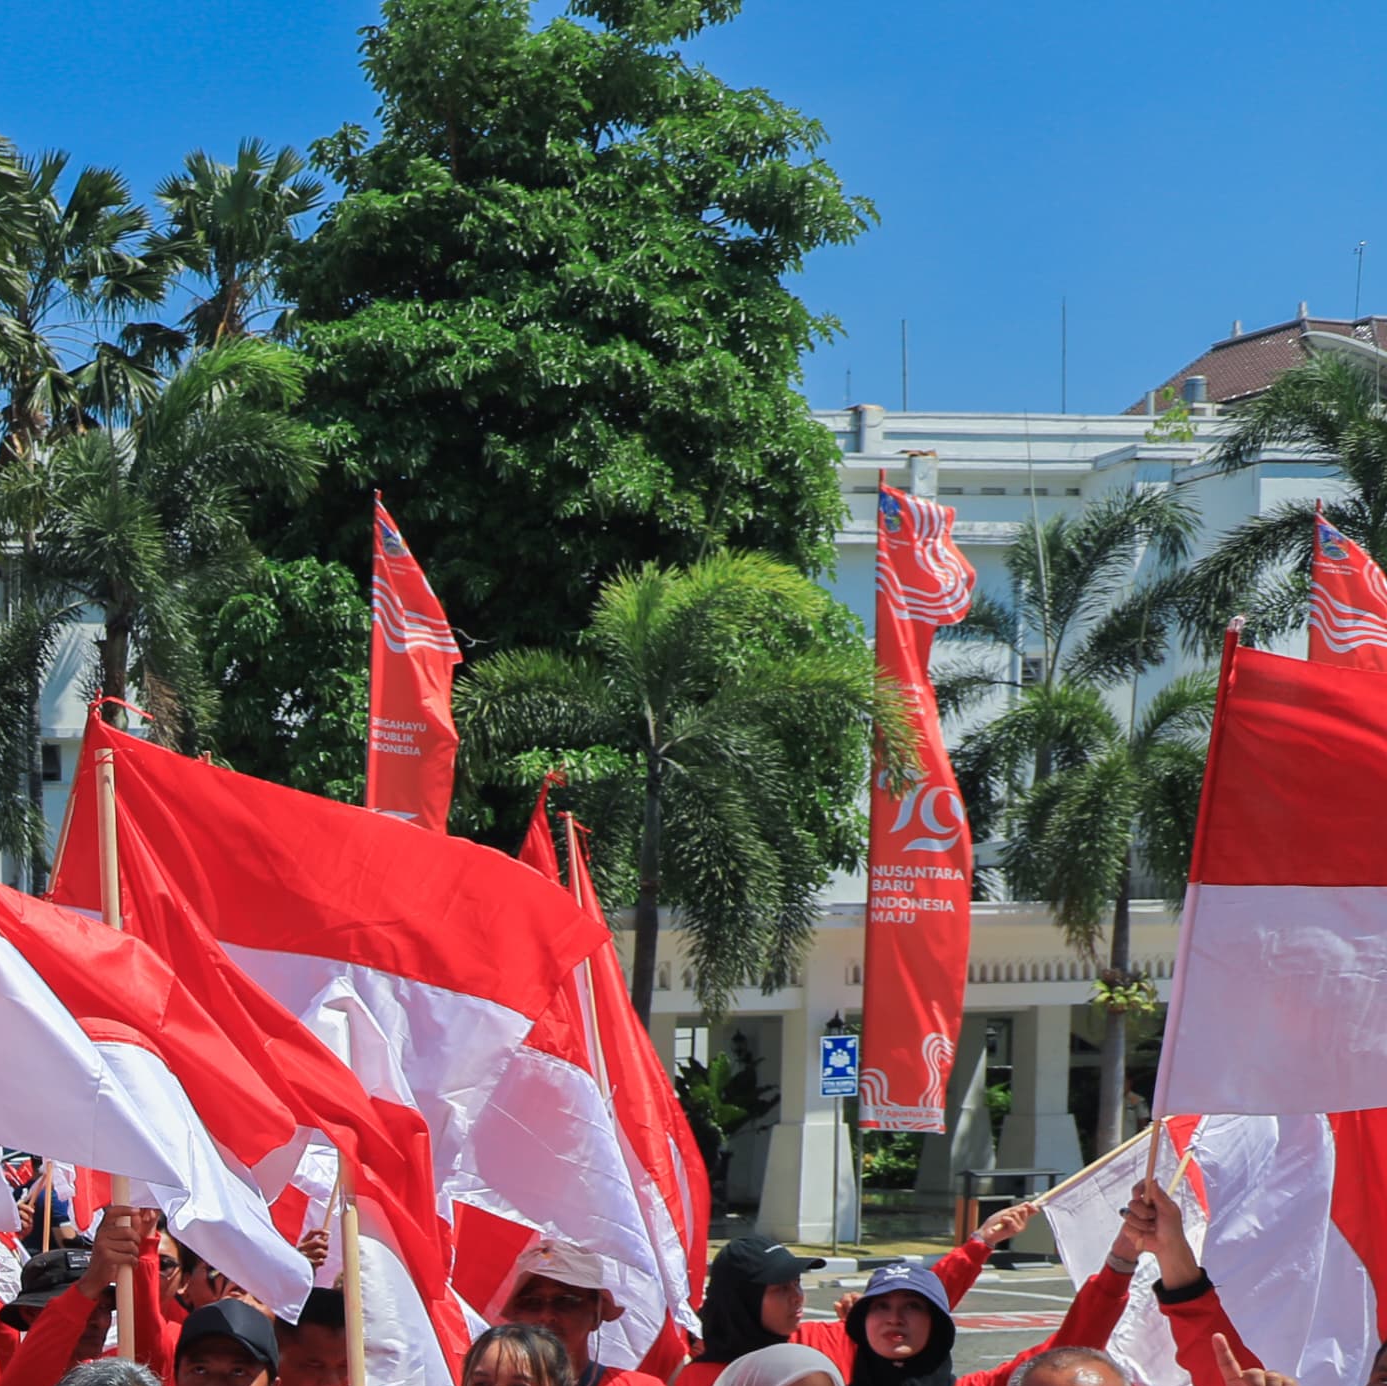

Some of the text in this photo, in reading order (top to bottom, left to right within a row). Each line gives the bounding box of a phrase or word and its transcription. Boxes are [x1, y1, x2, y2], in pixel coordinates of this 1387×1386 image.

[871, 865, 966, 881] NUSANTARA
[871, 879, 915, 893] BARU
[870, 896, 956, 913] INDONESIA
[870, 911, 916, 924] MAJU
